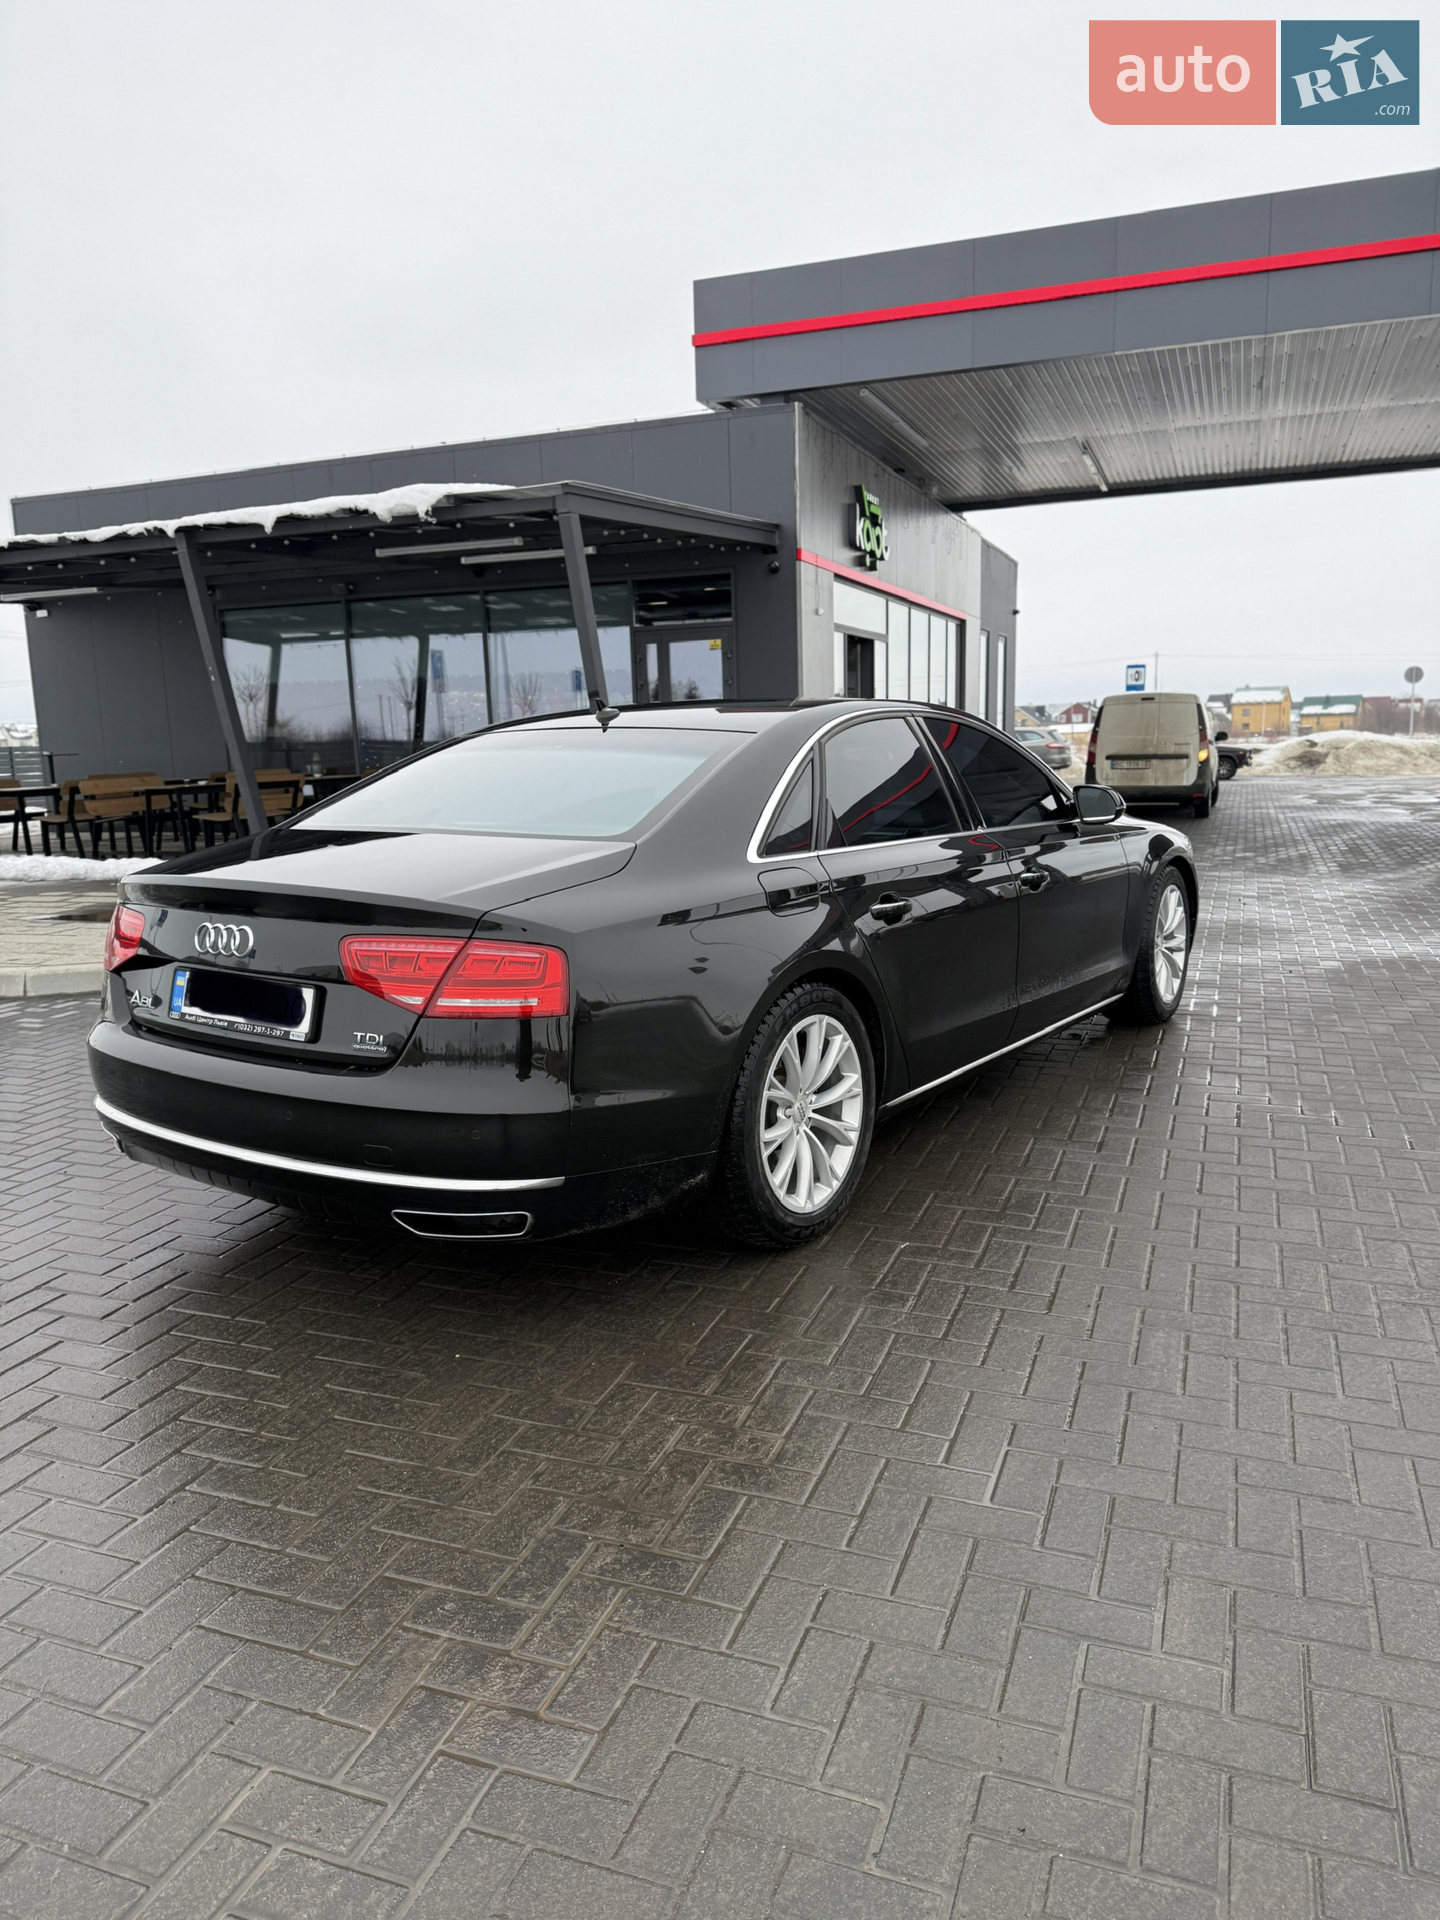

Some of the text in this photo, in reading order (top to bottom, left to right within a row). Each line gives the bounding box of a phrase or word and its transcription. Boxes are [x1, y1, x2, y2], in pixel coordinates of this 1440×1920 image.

[174, 997, 182, 1006] UA
[774, 989, 834, 1035] FM806
[253, 1025, 285, 1037] 297-1-297
[353, 1031, 384, 1045] TDI
